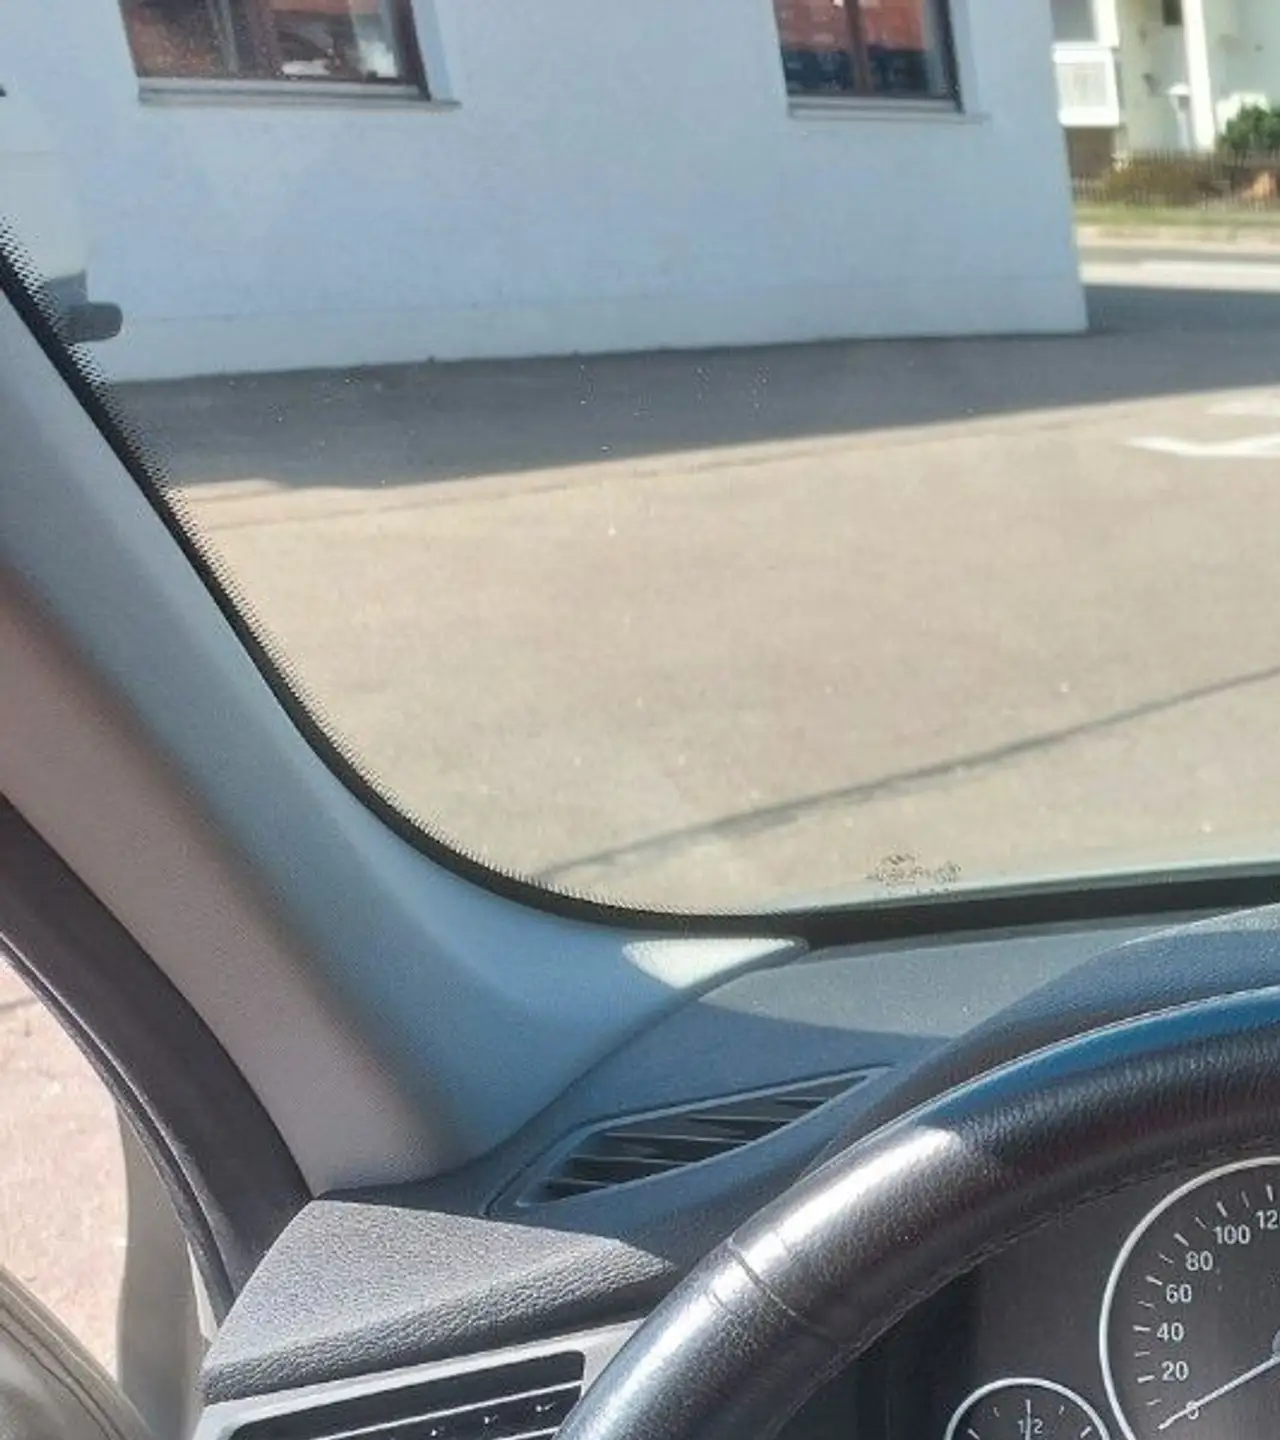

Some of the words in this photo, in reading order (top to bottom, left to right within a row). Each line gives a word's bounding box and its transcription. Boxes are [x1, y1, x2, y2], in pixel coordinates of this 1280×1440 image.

[1214, 1225, 1251, 1244] 100
[1185, 1251, 1214, 1271] 80
[1165, 1283, 1193, 1304] 60
[1156, 1322, 1185, 1343] 40
[1161, 1360, 1190, 1382] 20
